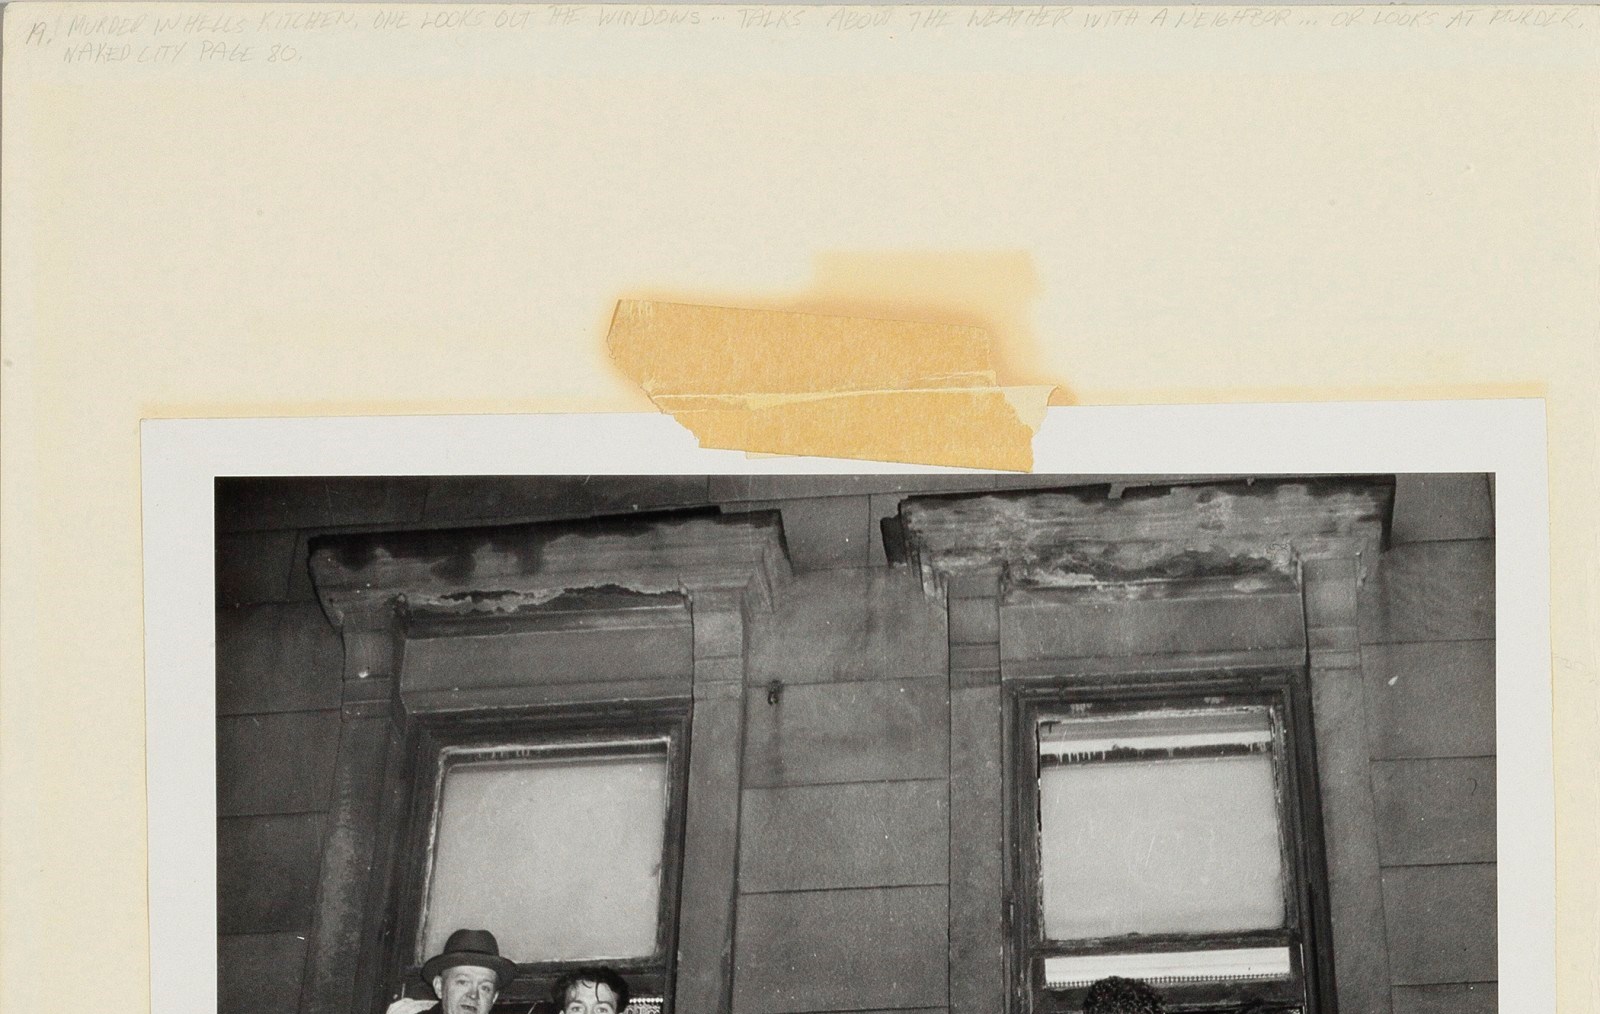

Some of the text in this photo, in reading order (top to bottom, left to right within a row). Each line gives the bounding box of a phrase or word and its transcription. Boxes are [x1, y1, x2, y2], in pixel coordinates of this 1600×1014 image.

[67, 13, 144, 37] MURDER
[373, 12, 412, 30] ONE
[421, 9, 483, 30] LOOKS
[494, 9, 531, 30] OUT
[548, 5, 583, 27] THE
[740, 9, 803, 30] TALKS
[909, 9, 948, 32] THE
[967, 5, 1074, 29] WEATHER
[1084, 9, 1140, 30] WITH
[1151, 8, 1170, 29] A
[1332, 10, 1364, 29] OR
[1373, 10, 1438, 28] LOOKS
[1446, 9, 1485, 31] AT
[64, 42, 131, 64] NAKED
[138, 42, 188, 63] CITY
[199, 40, 257, 62] PAGE
